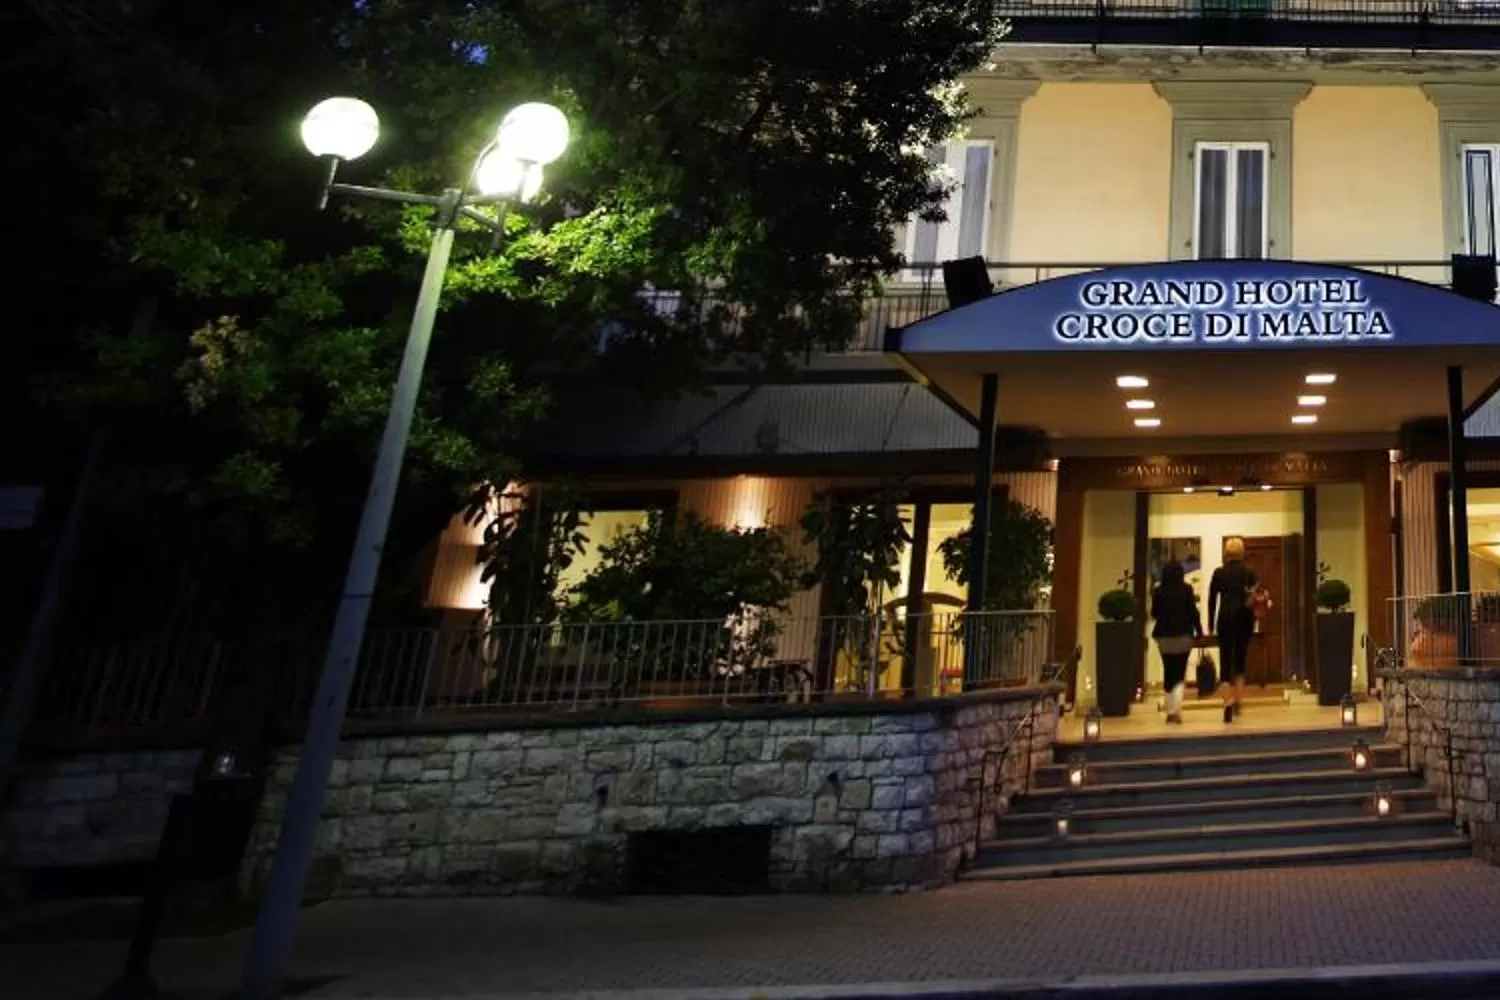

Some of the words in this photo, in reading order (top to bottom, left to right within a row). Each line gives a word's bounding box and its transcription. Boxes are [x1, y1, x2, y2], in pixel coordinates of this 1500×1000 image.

[1080, 278, 1225, 308] GRAND
[1235, 277, 1369, 306] HOTEL
[1053, 311, 1194, 342] CROCE
[1204, 310, 1255, 341] DI
[1258, 309, 1394, 339] MALTA
